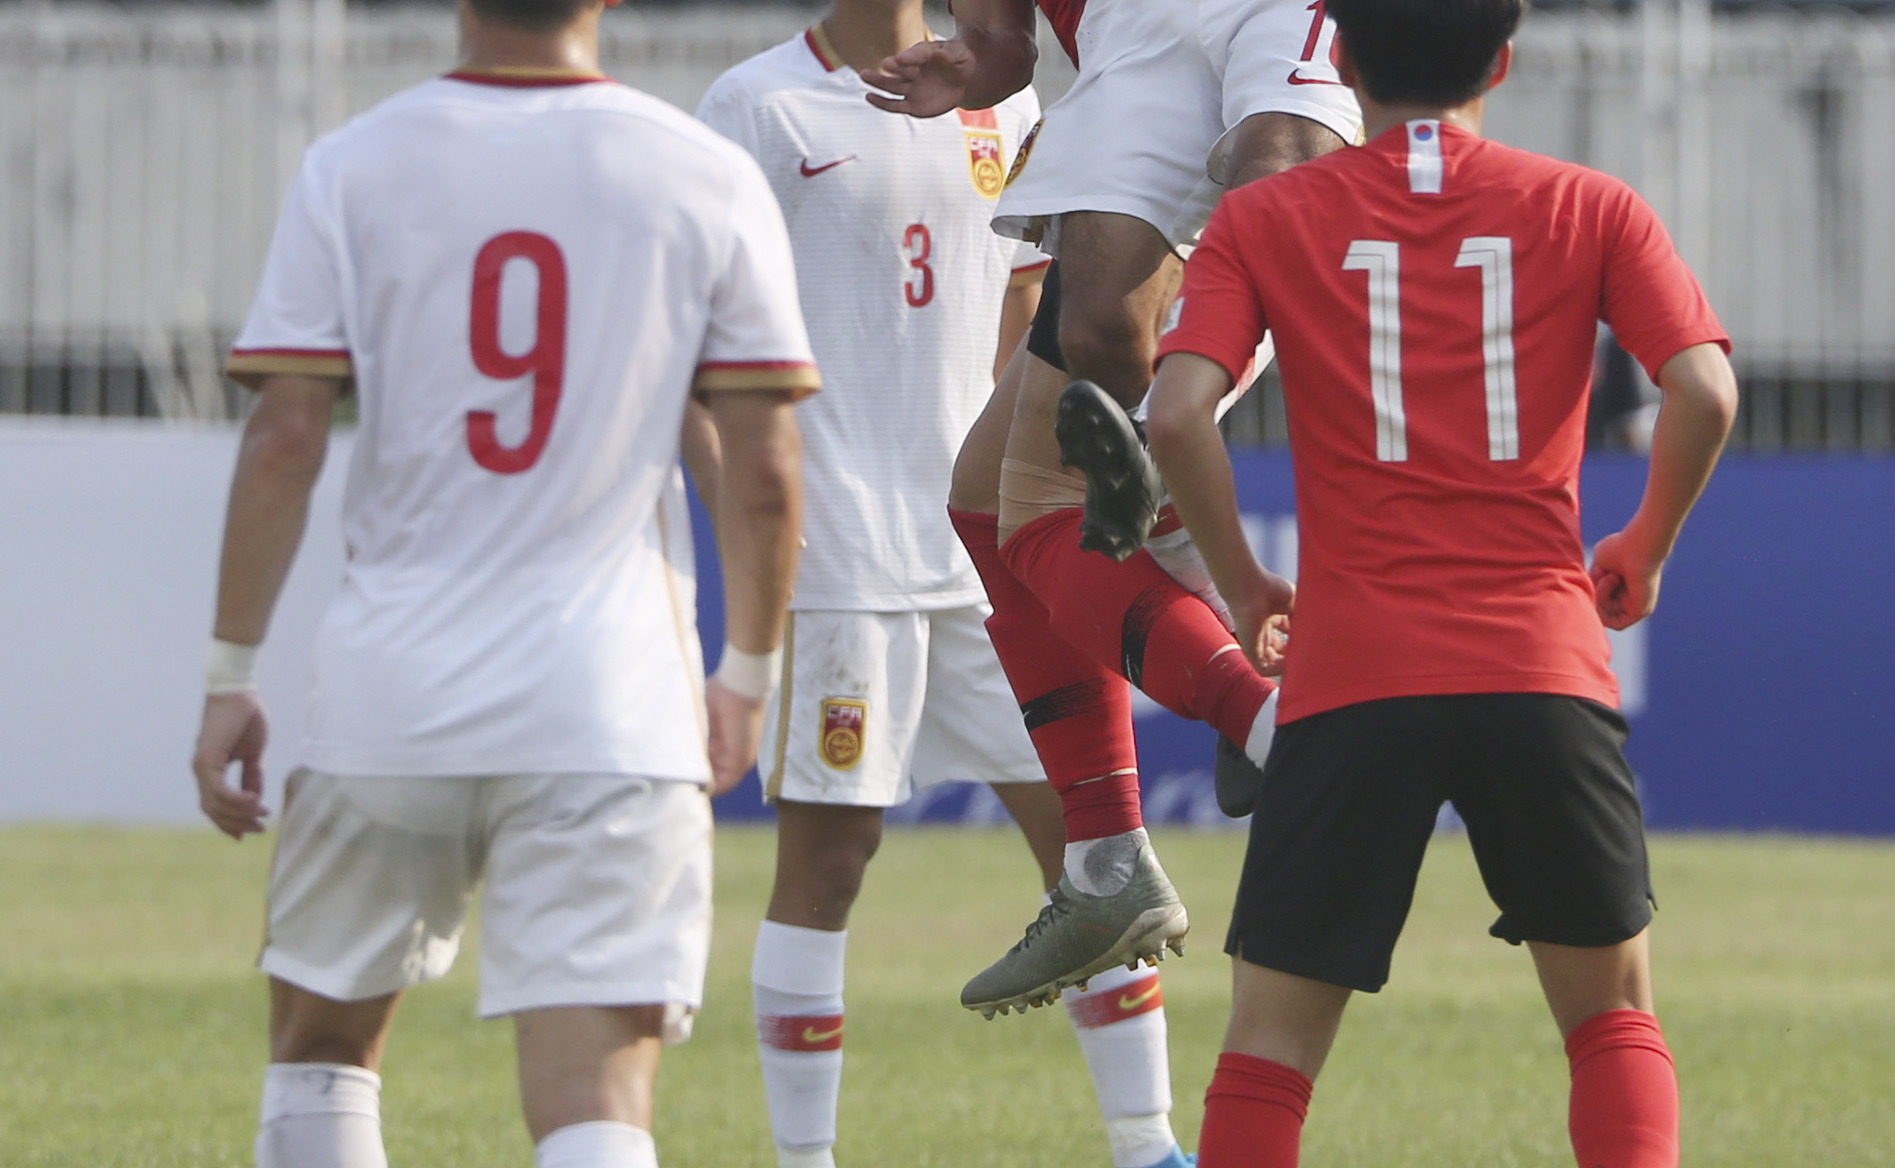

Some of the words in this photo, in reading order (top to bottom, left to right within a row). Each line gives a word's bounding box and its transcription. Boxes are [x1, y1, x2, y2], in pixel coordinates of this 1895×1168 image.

[904, 223, 934, 308] 3
[466, 229, 569, 475] 9
[1341, 236, 1520, 463] 11
[828, 705, 863, 721] CFA
